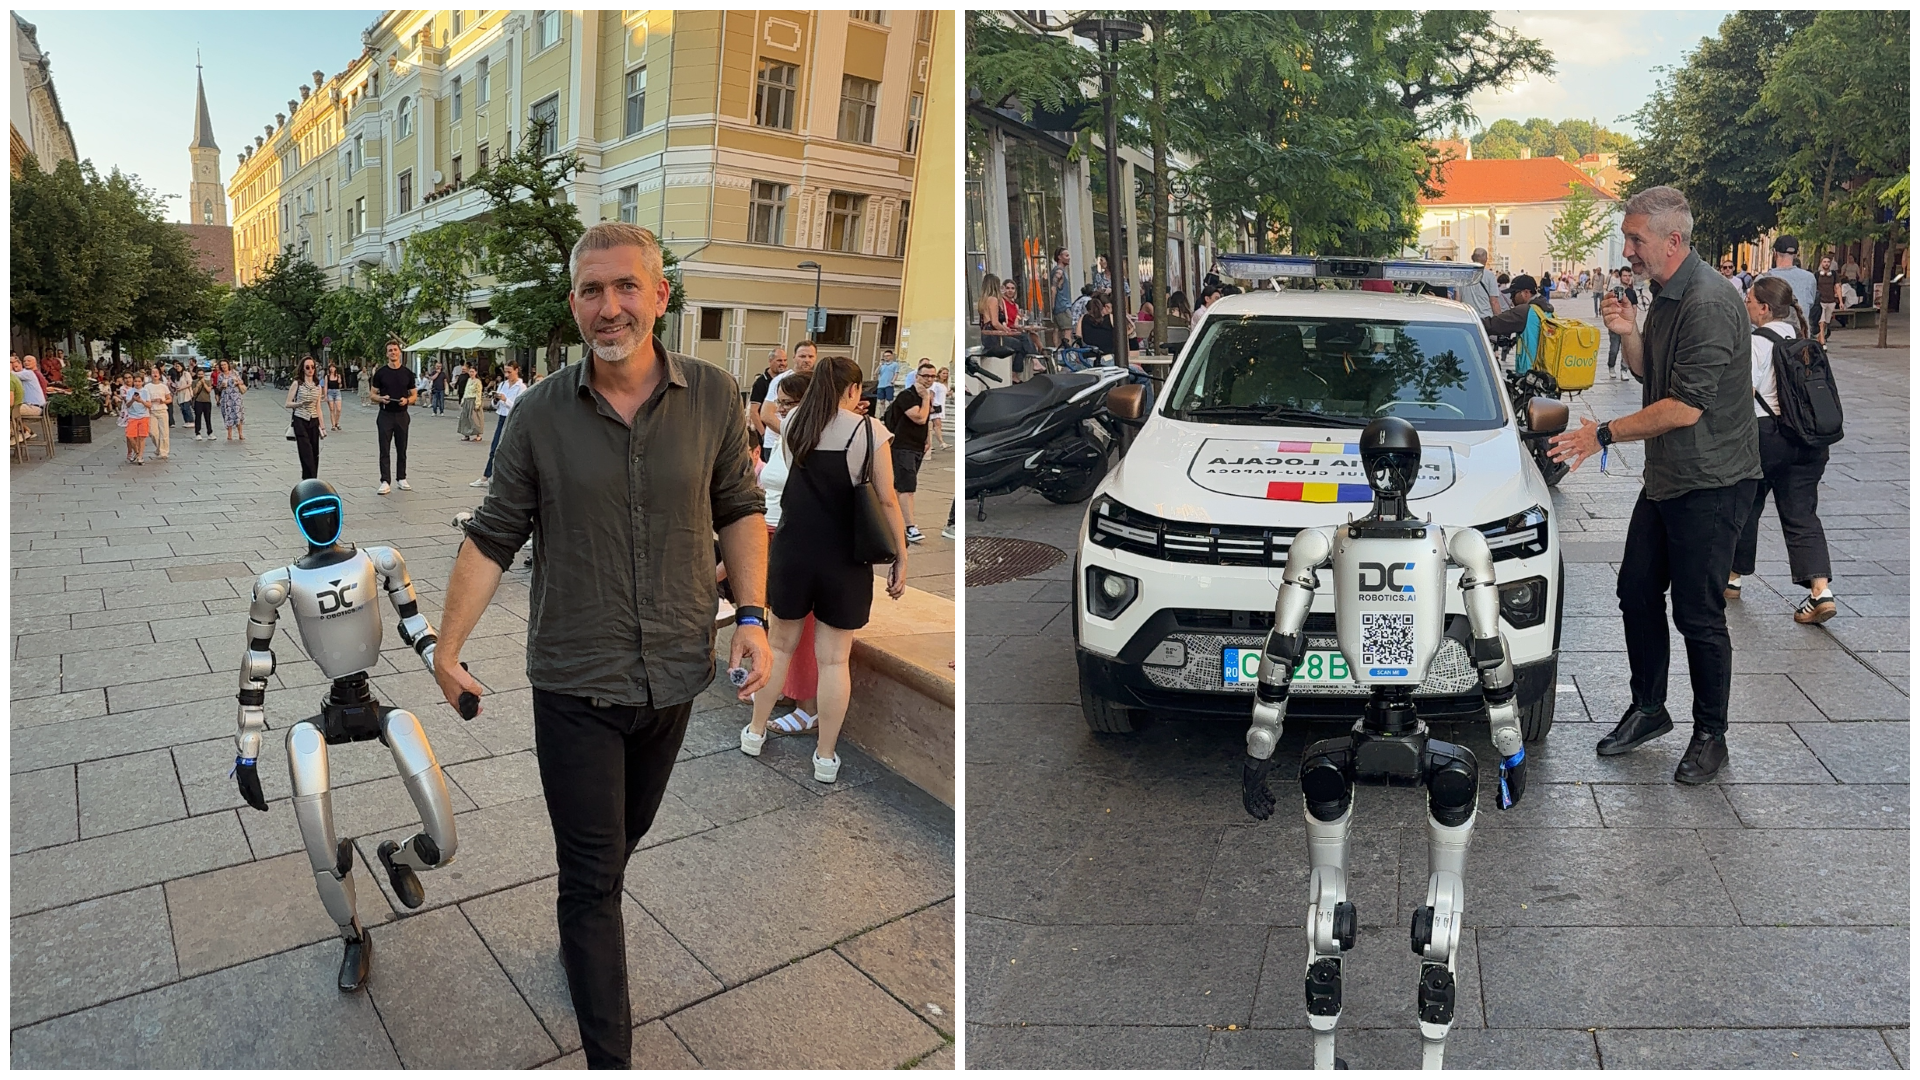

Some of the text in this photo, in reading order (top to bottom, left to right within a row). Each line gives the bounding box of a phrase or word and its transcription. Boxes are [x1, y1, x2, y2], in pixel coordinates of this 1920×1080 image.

[1564, 355, 1594, 368] Glovo
[1359, 562, 1416, 592] DC
[316, 582, 357, 615] DC
[1359, 594, 1417, 602] ROBOTICS.AI
[1225, 667, 1238, 678] RO
